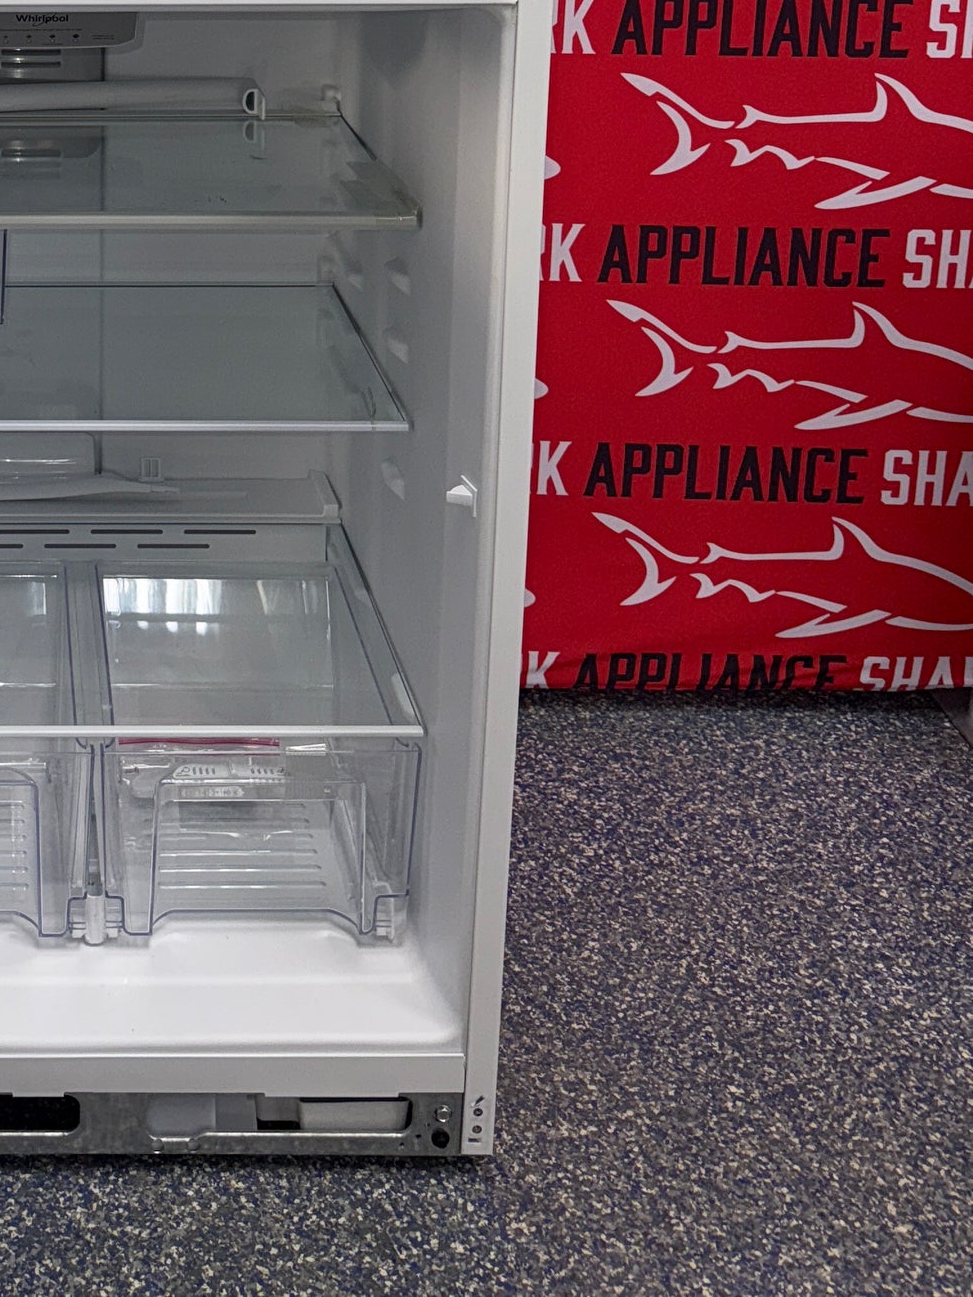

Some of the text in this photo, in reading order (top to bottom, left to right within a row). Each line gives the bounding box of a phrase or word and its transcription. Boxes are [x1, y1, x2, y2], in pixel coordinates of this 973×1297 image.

[15, 14, 69, 24] Whirlpool
[597, 224, 892, 289] APPLIANCE
[902, 229, 973, 289] SH
[583, 441, 870, 505] APPLIANCE
